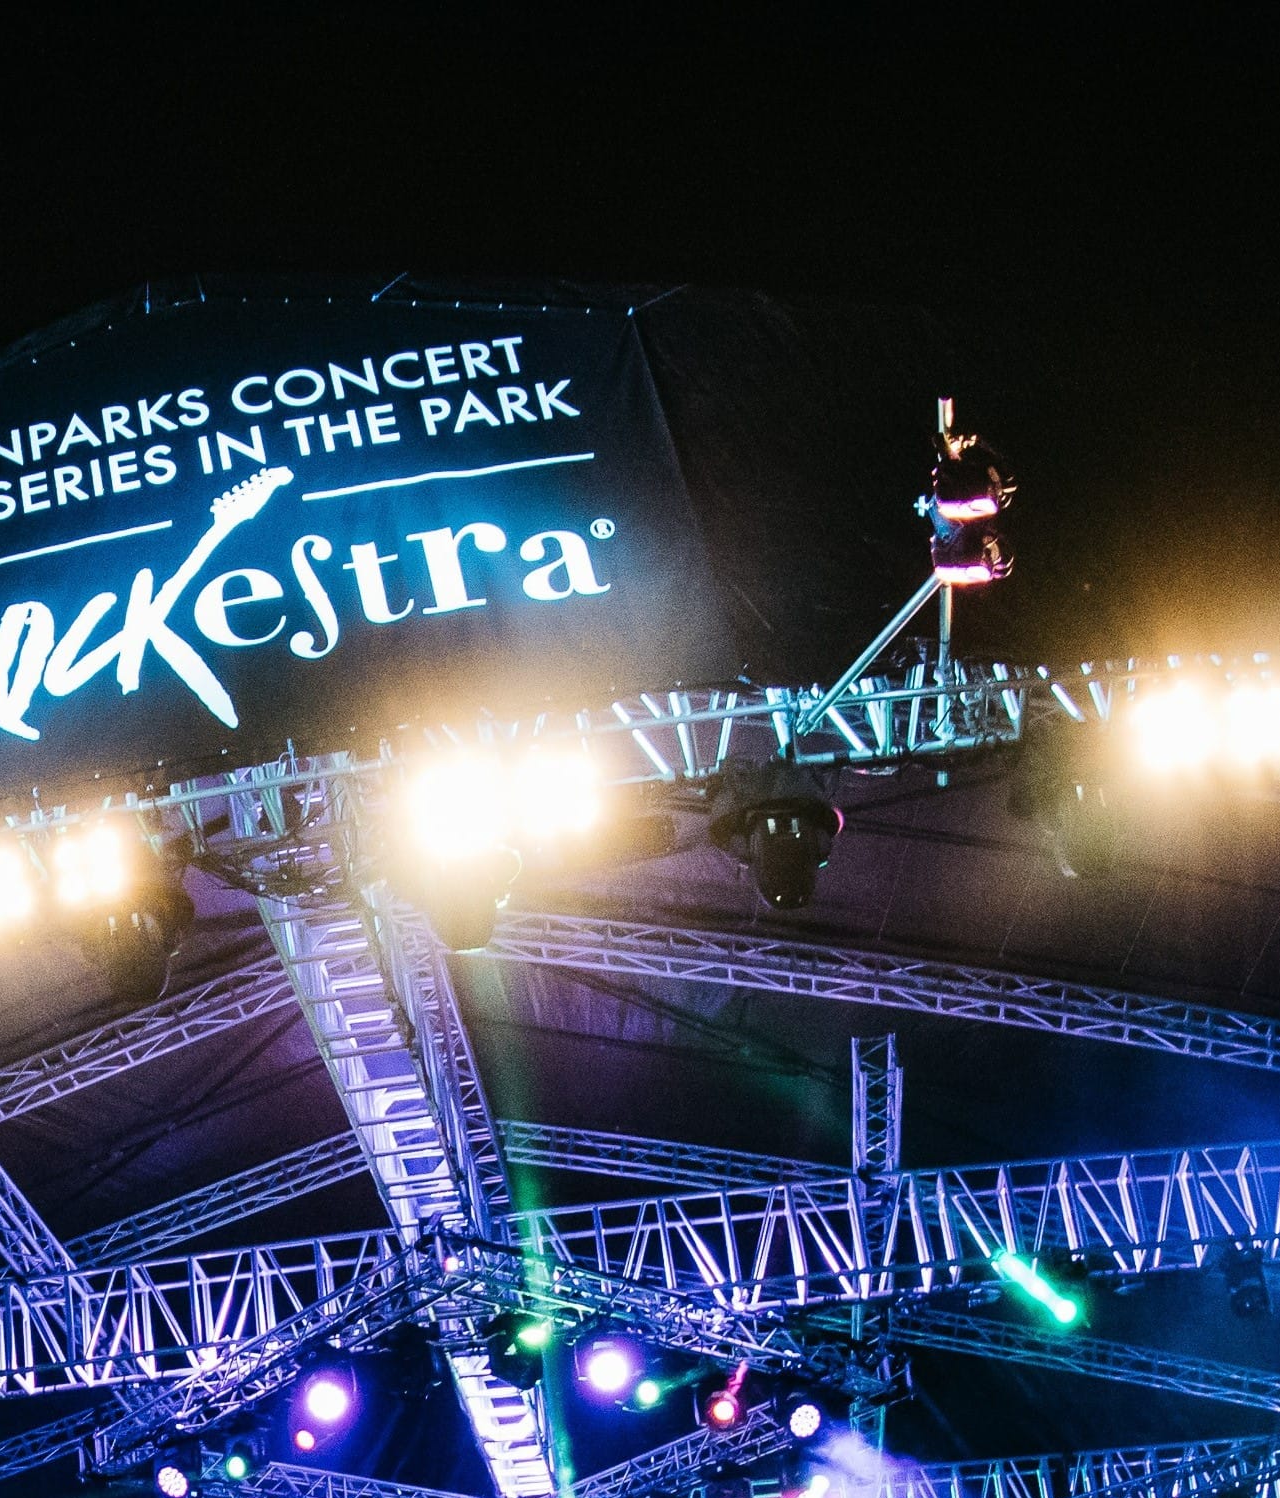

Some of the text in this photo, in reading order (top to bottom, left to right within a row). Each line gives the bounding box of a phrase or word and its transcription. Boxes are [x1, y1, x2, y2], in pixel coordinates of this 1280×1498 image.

[231, 336, 523, 415] CONCERT
[198, 425, 267, 475] IN
[284, 403, 401, 457] THE
[420, 379, 581, 436] PARK
